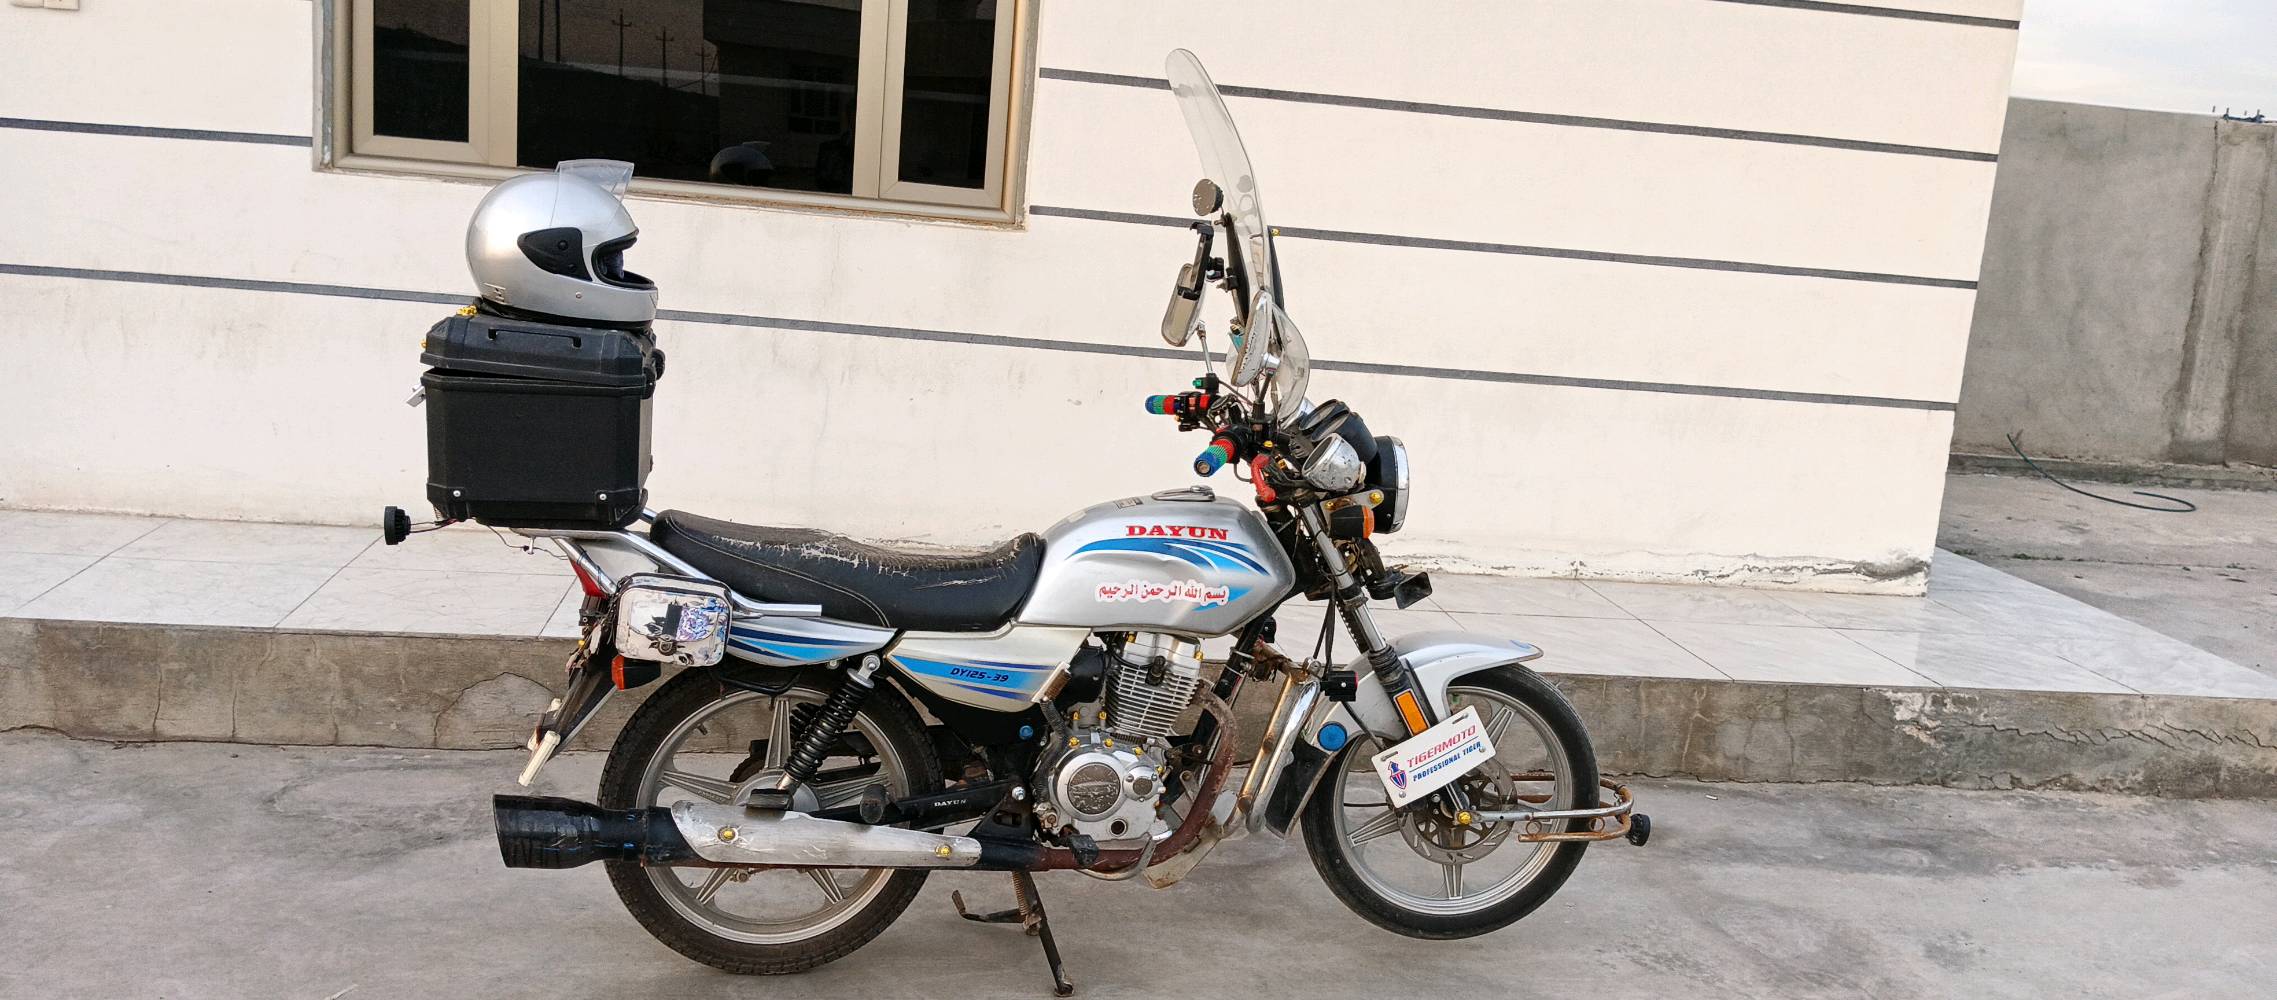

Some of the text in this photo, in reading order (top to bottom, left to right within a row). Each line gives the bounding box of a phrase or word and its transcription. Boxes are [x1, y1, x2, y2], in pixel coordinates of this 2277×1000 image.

[1126, 525, 1230, 540] DAYUN
[1099, 584, 1227, 603] بسم الله الرحمن الرحيم
[950, 667, 1009, 682] DY125-39
[1407, 725, 1476, 767] TIGERMOTO
[1413, 741, 1481, 782] PROFESSIONAL TIGER
[934, 799, 967, 807] DAYUN
